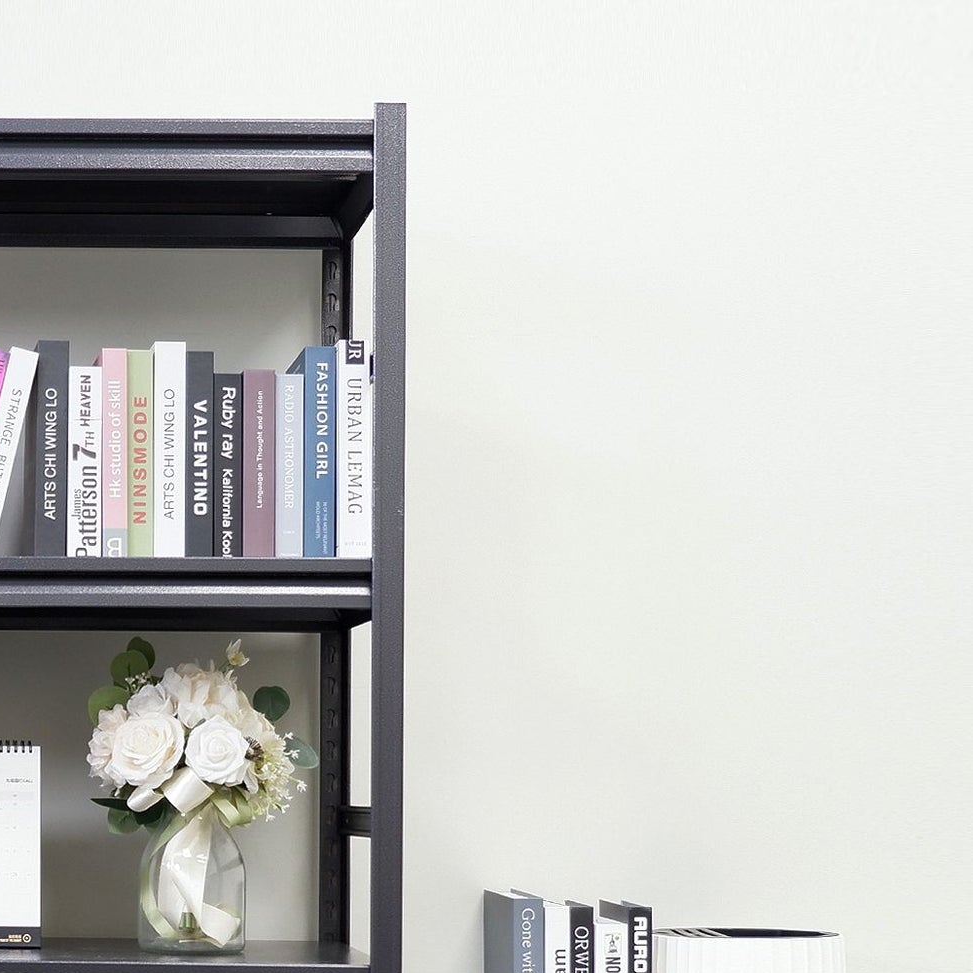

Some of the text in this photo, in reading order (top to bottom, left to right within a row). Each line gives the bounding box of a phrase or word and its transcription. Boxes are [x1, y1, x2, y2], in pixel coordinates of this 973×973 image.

[0, 388, 23, 446] STRANGE
[44, 388, 58, 520] ARTS CHI WING LO
[80, 374, 92, 427] HEAVEN
[107, 380, 122, 499] Hk studio of skill
[163, 388, 175, 520] ARTS CHI WING LO
[193, 399, 208, 516] VALENTINO
[220, 434, 233, 460] ray
[222, 387, 237, 429] Ruby
[256, 431, 265, 461] Thought
[284, 385, 295, 509] RADIO ASTRONOMER
[316, 362, 328, 480] FASHION GIRL
[346, 378, 363, 514] URBAN LEMAG
[70, 488, 82, 520] James
[133, 396, 148, 525] NINSMODE
[521, 908, 535, 949] Gone
